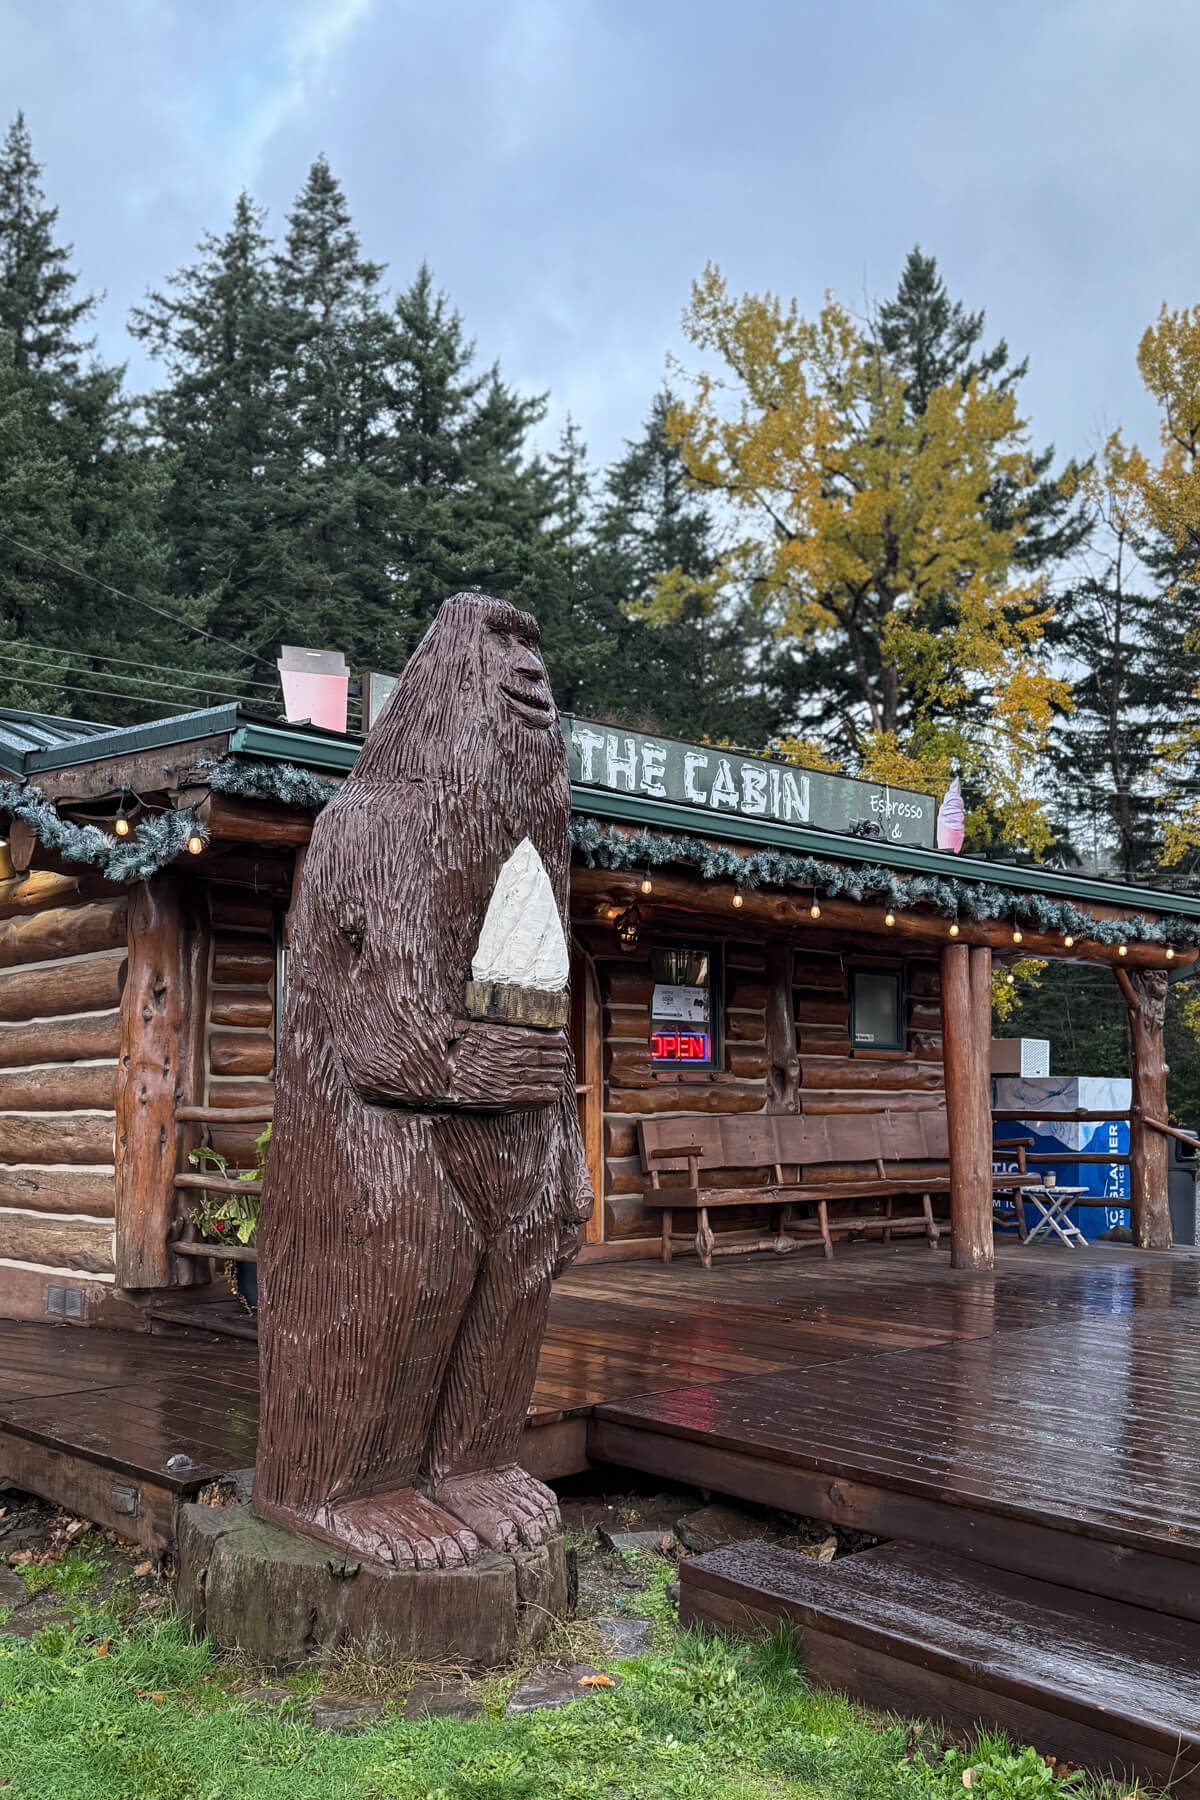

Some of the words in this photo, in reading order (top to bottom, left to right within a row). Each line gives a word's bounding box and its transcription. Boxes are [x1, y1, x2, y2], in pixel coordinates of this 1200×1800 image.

[572, 728, 666, 798] THE
[684, 751, 811, 823] CABIN
[870, 794, 923, 819] Espresso
[891, 823, 903, 839] &
[651, 1036, 704, 1058] OPEN
